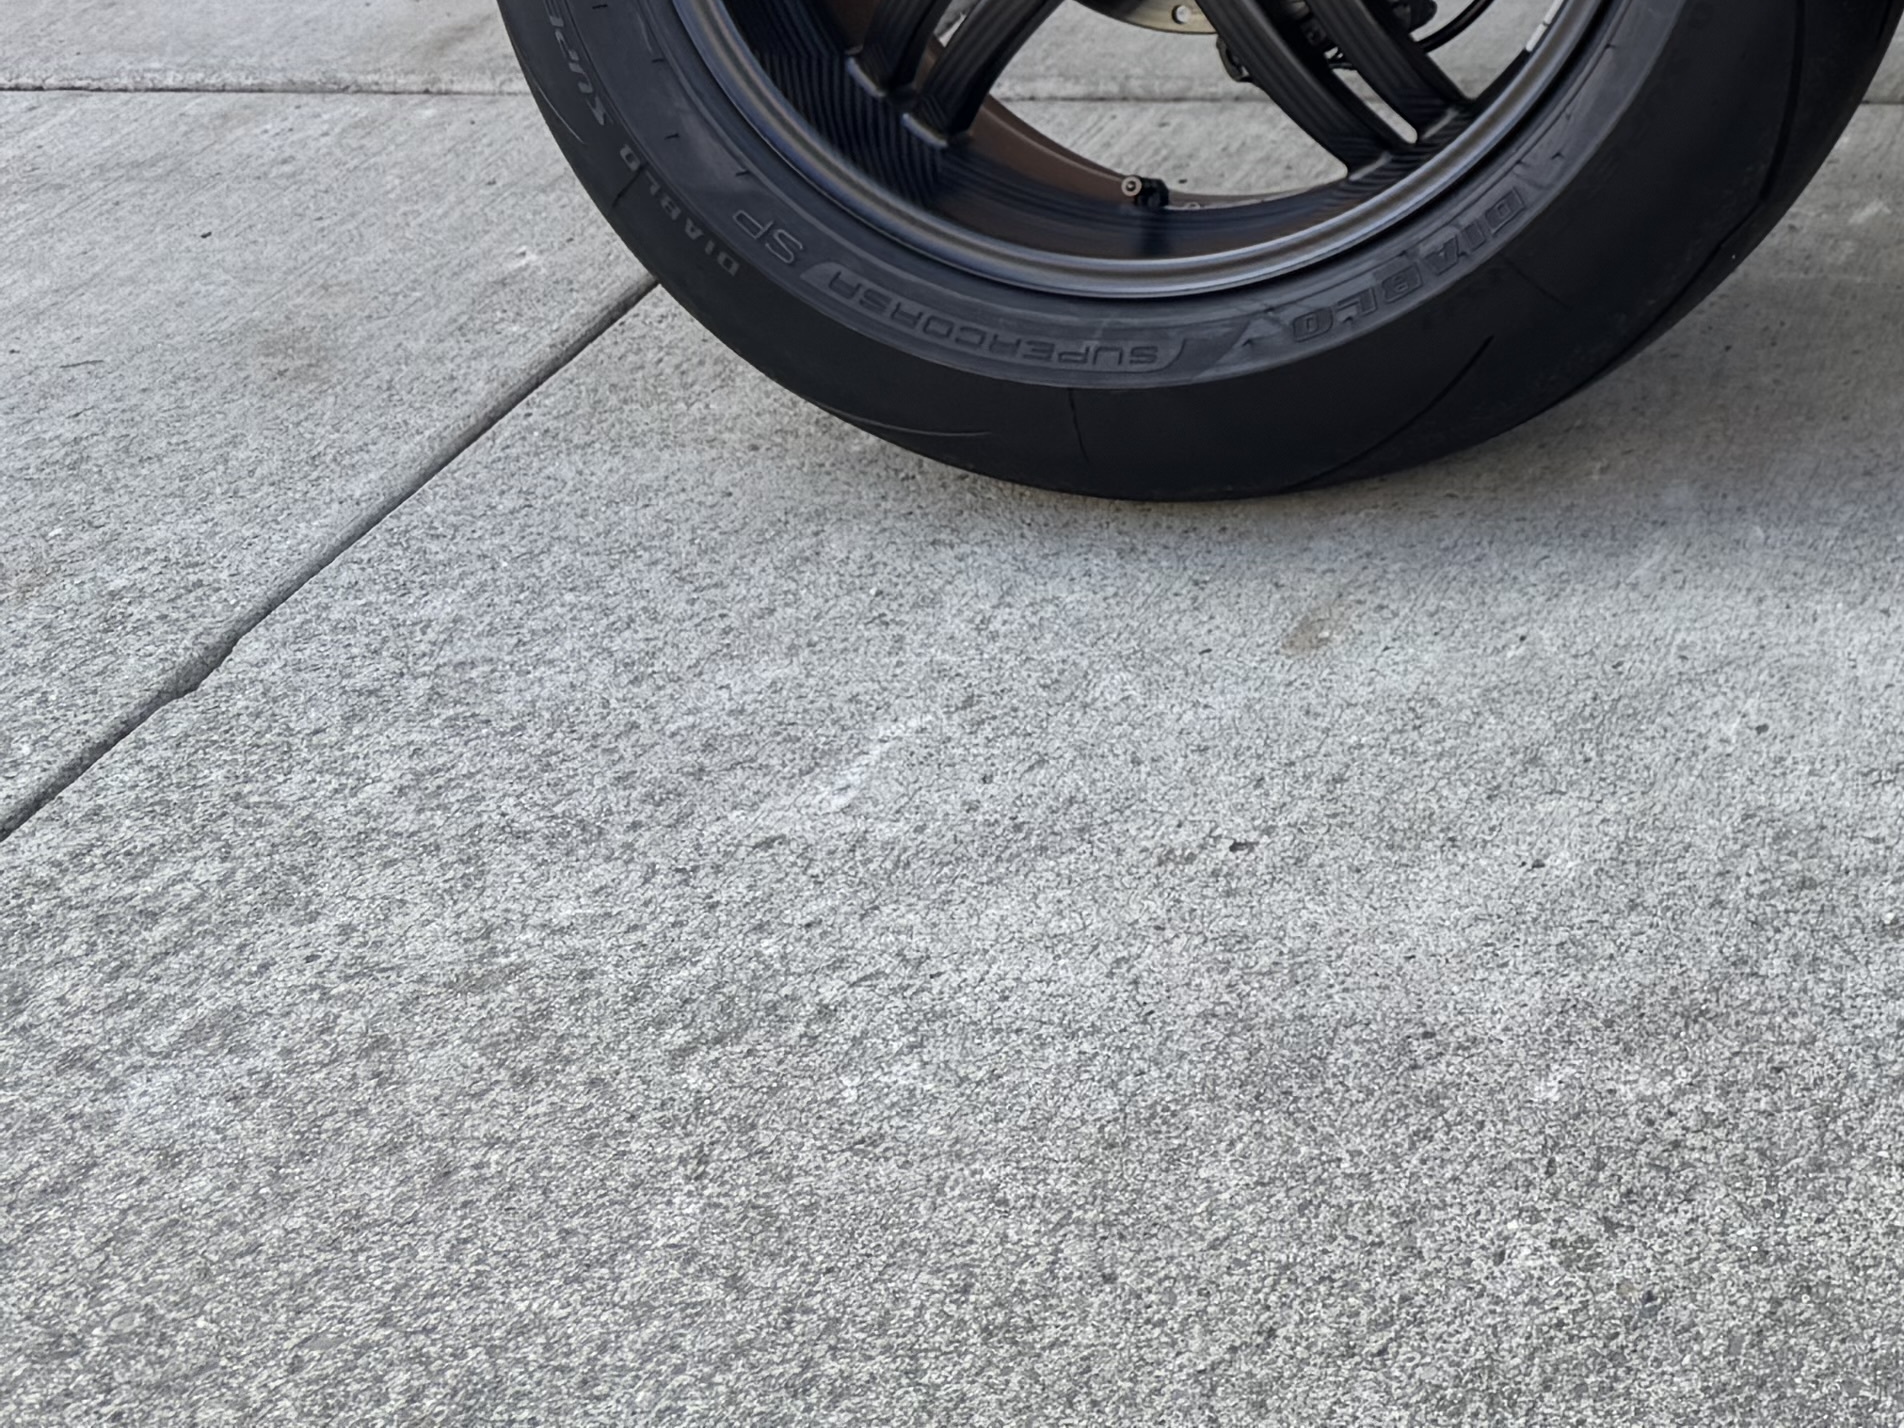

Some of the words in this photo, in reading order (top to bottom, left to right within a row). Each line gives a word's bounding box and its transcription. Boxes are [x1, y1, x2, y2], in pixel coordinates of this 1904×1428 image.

[615, 139, 745, 277] DIABLO
[730, 196, 807, 268] SP
[1286, 184, 1532, 344] DIABLO
[825, 267, 1160, 367] SUPERCORSA
